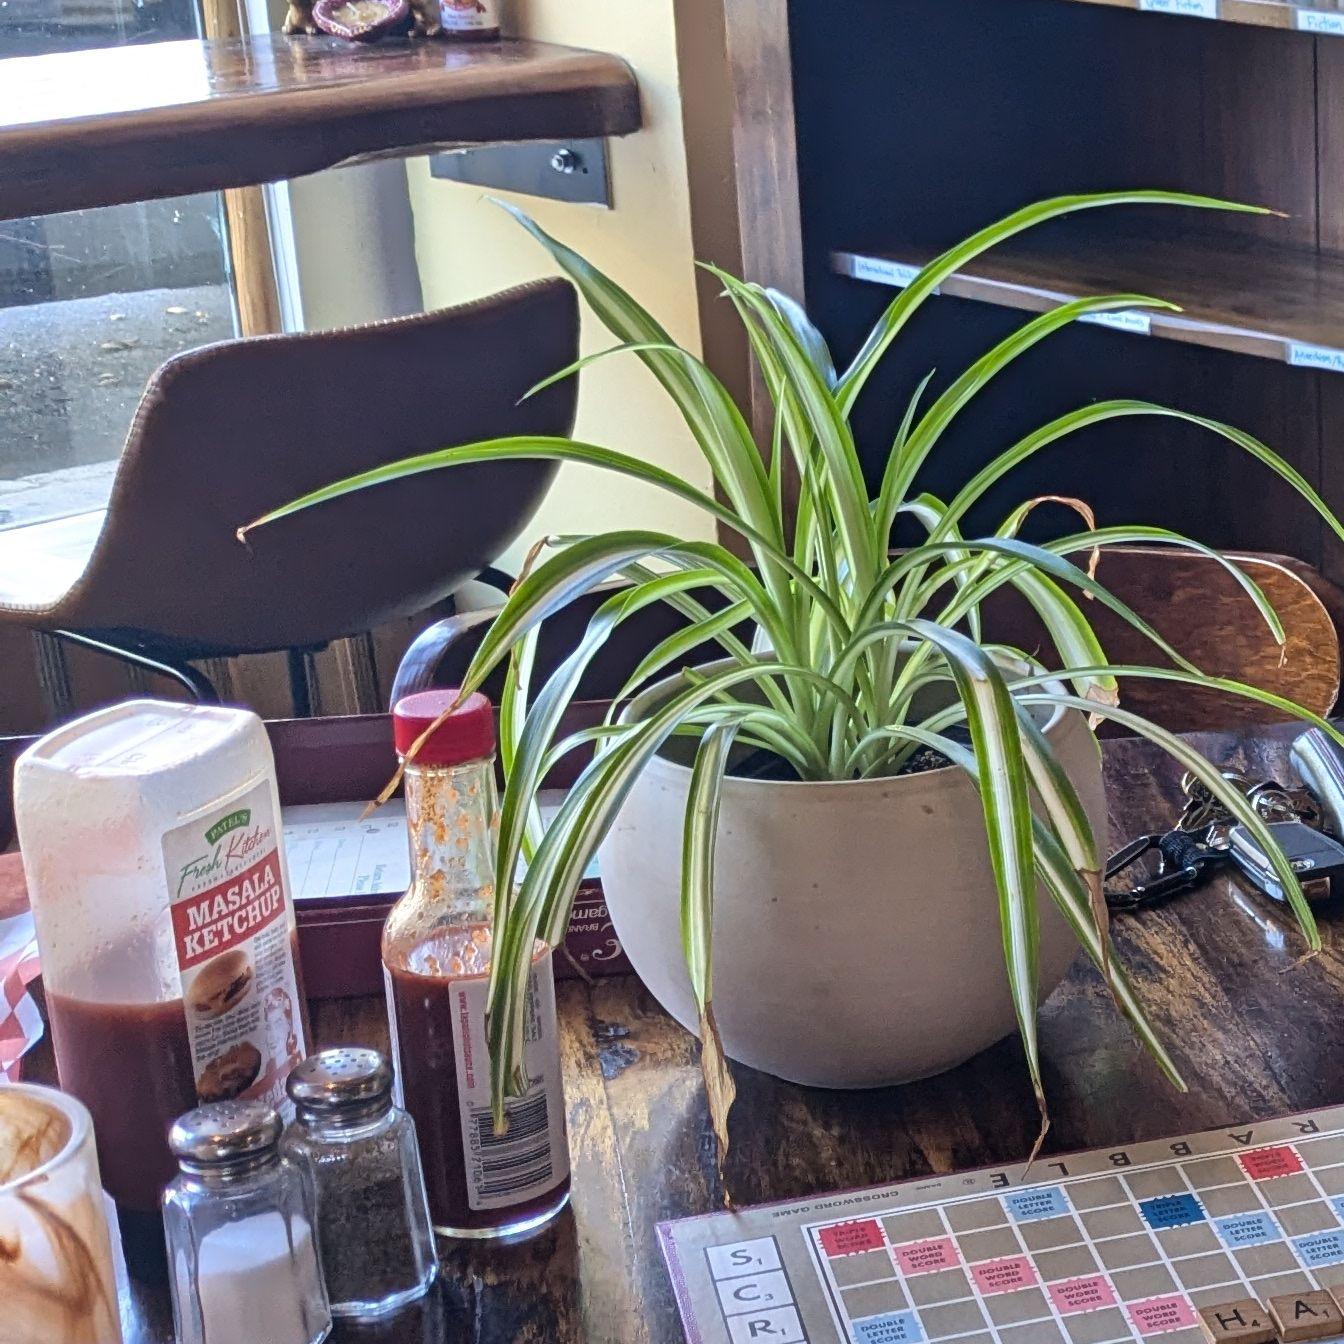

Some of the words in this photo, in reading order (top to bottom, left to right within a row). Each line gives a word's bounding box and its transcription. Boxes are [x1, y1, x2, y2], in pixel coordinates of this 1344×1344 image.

[177, 850, 223, 899] Fresh
[225, 826, 271, 869] Kitchen
[186, 864, 276, 931] MASALA
[183, 885, 282, 959] KETCHUP
[1011, 1193, 1052, 1204] DOUBLE
[1017, 1199, 1052, 1209] LETTER
[1021, 1205, 1055, 1215] SCORE
[1222, 1218, 1263, 1229] DOUBLE
[1229, 1225, 1263, 1235] LETTER
[1233, 1230, 1268, 1241] SCORE
[1298, 1236, 1339, 1248] DOUBLE
[901, 1244, 944, 1256] DOUBLE
[1305, 1243, 1339, 1253] LETTER
[907, 1251, 943, 1262] WORD
[1309, 1249, 1344, 1260] SCORE
[911, 1257, 947, 1268] SCORE
[861, 1318, 905, 1331] DOUBLE
[866, 1326, 904, 1338] LETTER
[870, 1333, 908, 1344] SCORE
